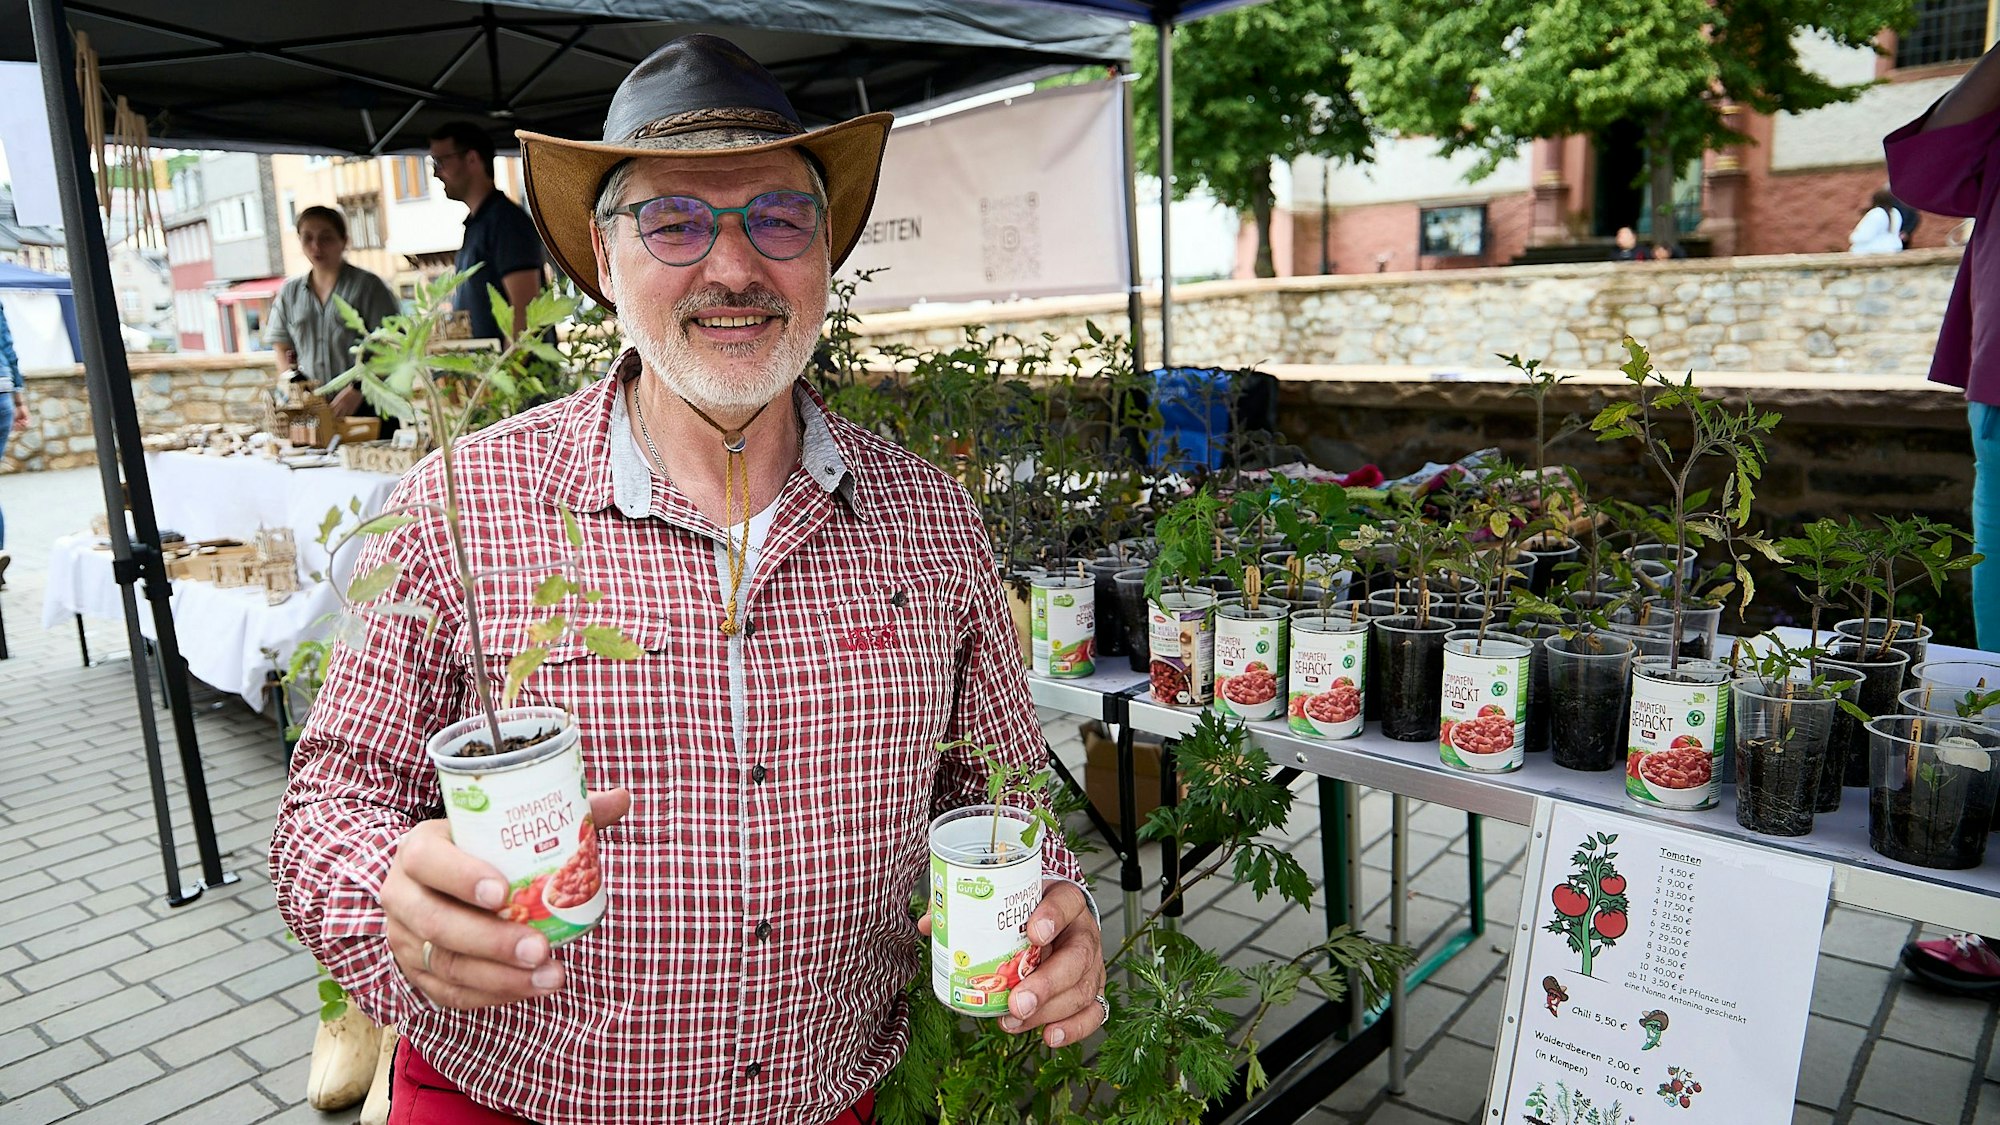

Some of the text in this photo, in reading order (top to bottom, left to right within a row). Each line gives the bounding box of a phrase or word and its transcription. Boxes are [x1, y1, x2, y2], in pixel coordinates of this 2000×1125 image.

[860, 216, 922, 246] BEITEN
[1298, 651, 1326, 661] TOMATEN
[1295, 660, 1332, 676] GEHACKT
[1636, 700, 1666, 714] TOMATEN
[1632, 710, 1674, 732] GEHACKT
[506, 790, 562, 823] TOMATEN
[500, 801, 574, 850] GEHACKT
[1660, 848, 1702, 865] Tomaten
[1669, 868, 1687, 877] 4,50
[1667, 879, 1685, 888] 9,00
[1004, 880, 1039, 908] TOMATEN
[1665, 889, 1687, 900] 13,50
[997, 888, 1041, 930] GEHAC
[1664, 900, 1685, 911] 17,50
[1662, 912, 1683, 923] 21,50
[1660, 923, 1683, 934] 25,50
[1658, 933, 1681, 945] 29,50
[1657, 945, 1680, 956] 33,00
[1655, 956, 1678, 968] 36,50
[1654, 967, 1676, 978] 40,00
[1651, 978, 1669, 988] 3,50
[1689, 989, 1719, 1003] Pflanze
[1721, 1000, 1736, 1008] und
[1624, 981, 1747, 1024] eine Nonna Antonina geschenkt
[1572, 1006, 1591, 1019] Chili
[1535, 1030, 1601, 1062] Walderdbeeren
[1535, 1049, 1546, 1059] (in
[1549, 1054, 1588, 1076] Klompen)
